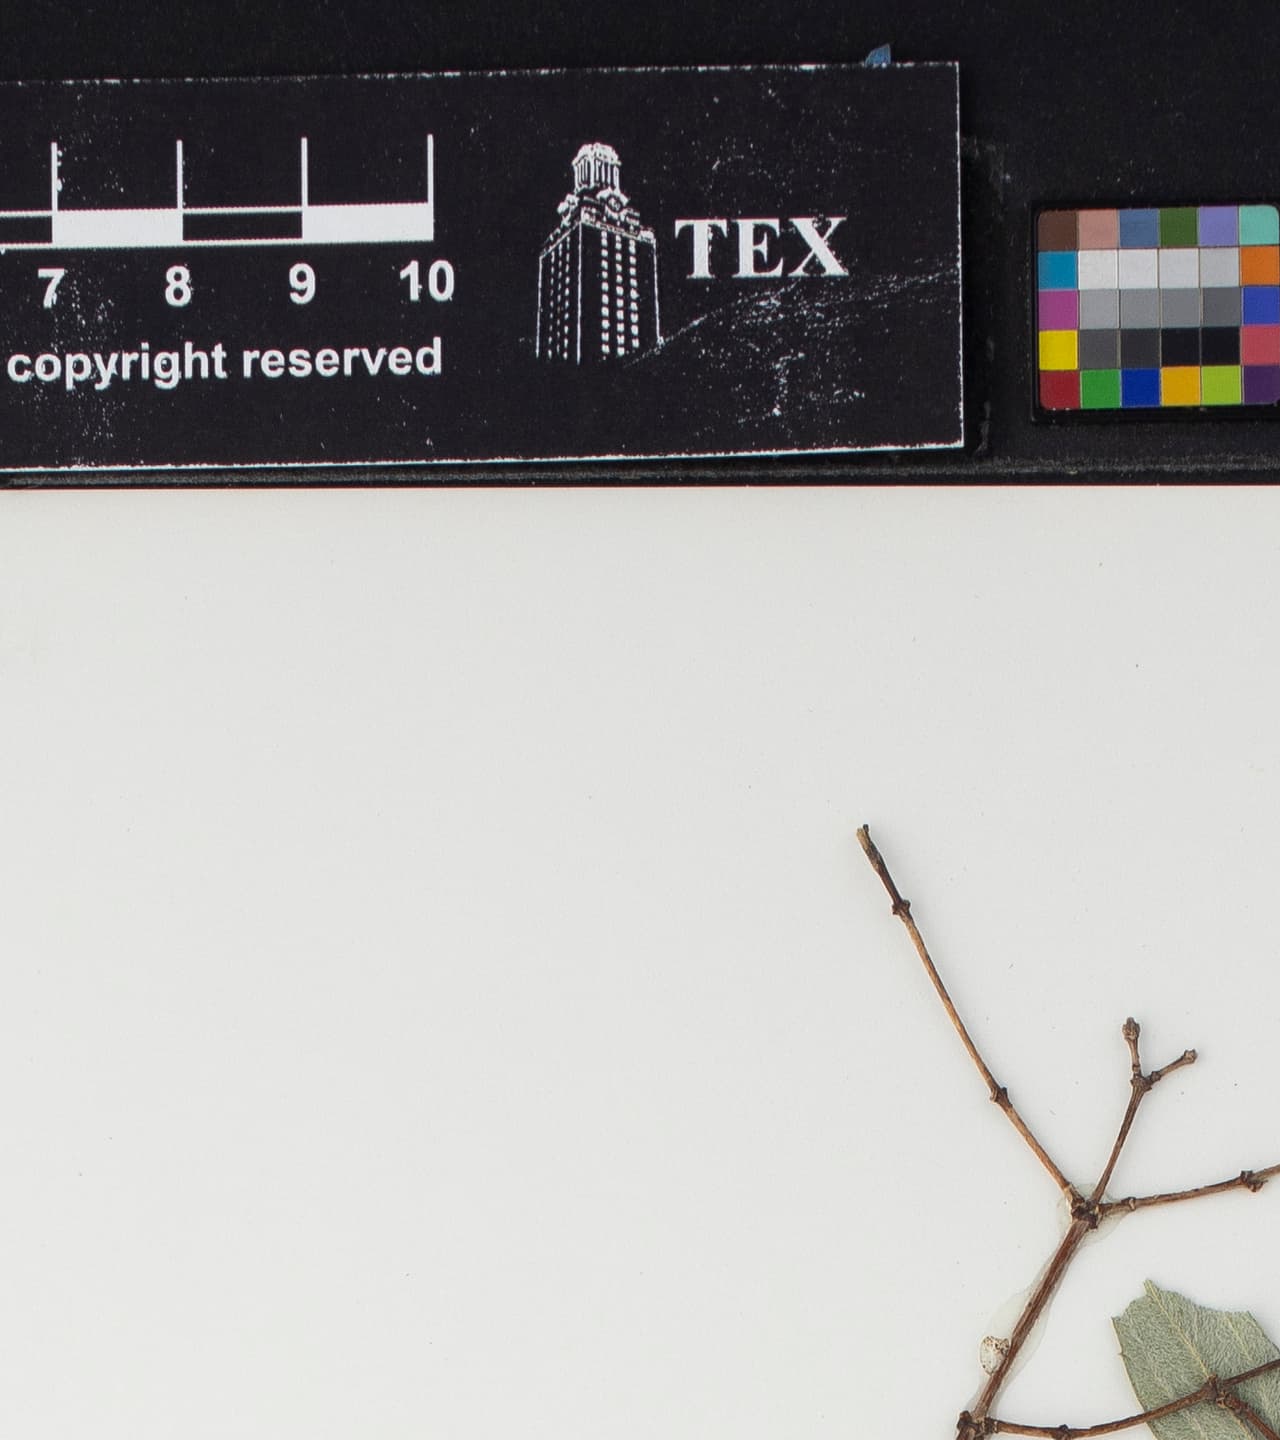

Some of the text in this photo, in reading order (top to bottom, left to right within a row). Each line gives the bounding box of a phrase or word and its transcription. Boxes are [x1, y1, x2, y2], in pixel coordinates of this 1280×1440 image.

[674, 216, 850, 280] TEX
[37, 267, 67, 309] 7
[164, 265, 194, 307] 8
[288, 262, 316, 305] 9
[399, 259, 455, 302] 10
[7, 336, 442, 391] copyright reserved
